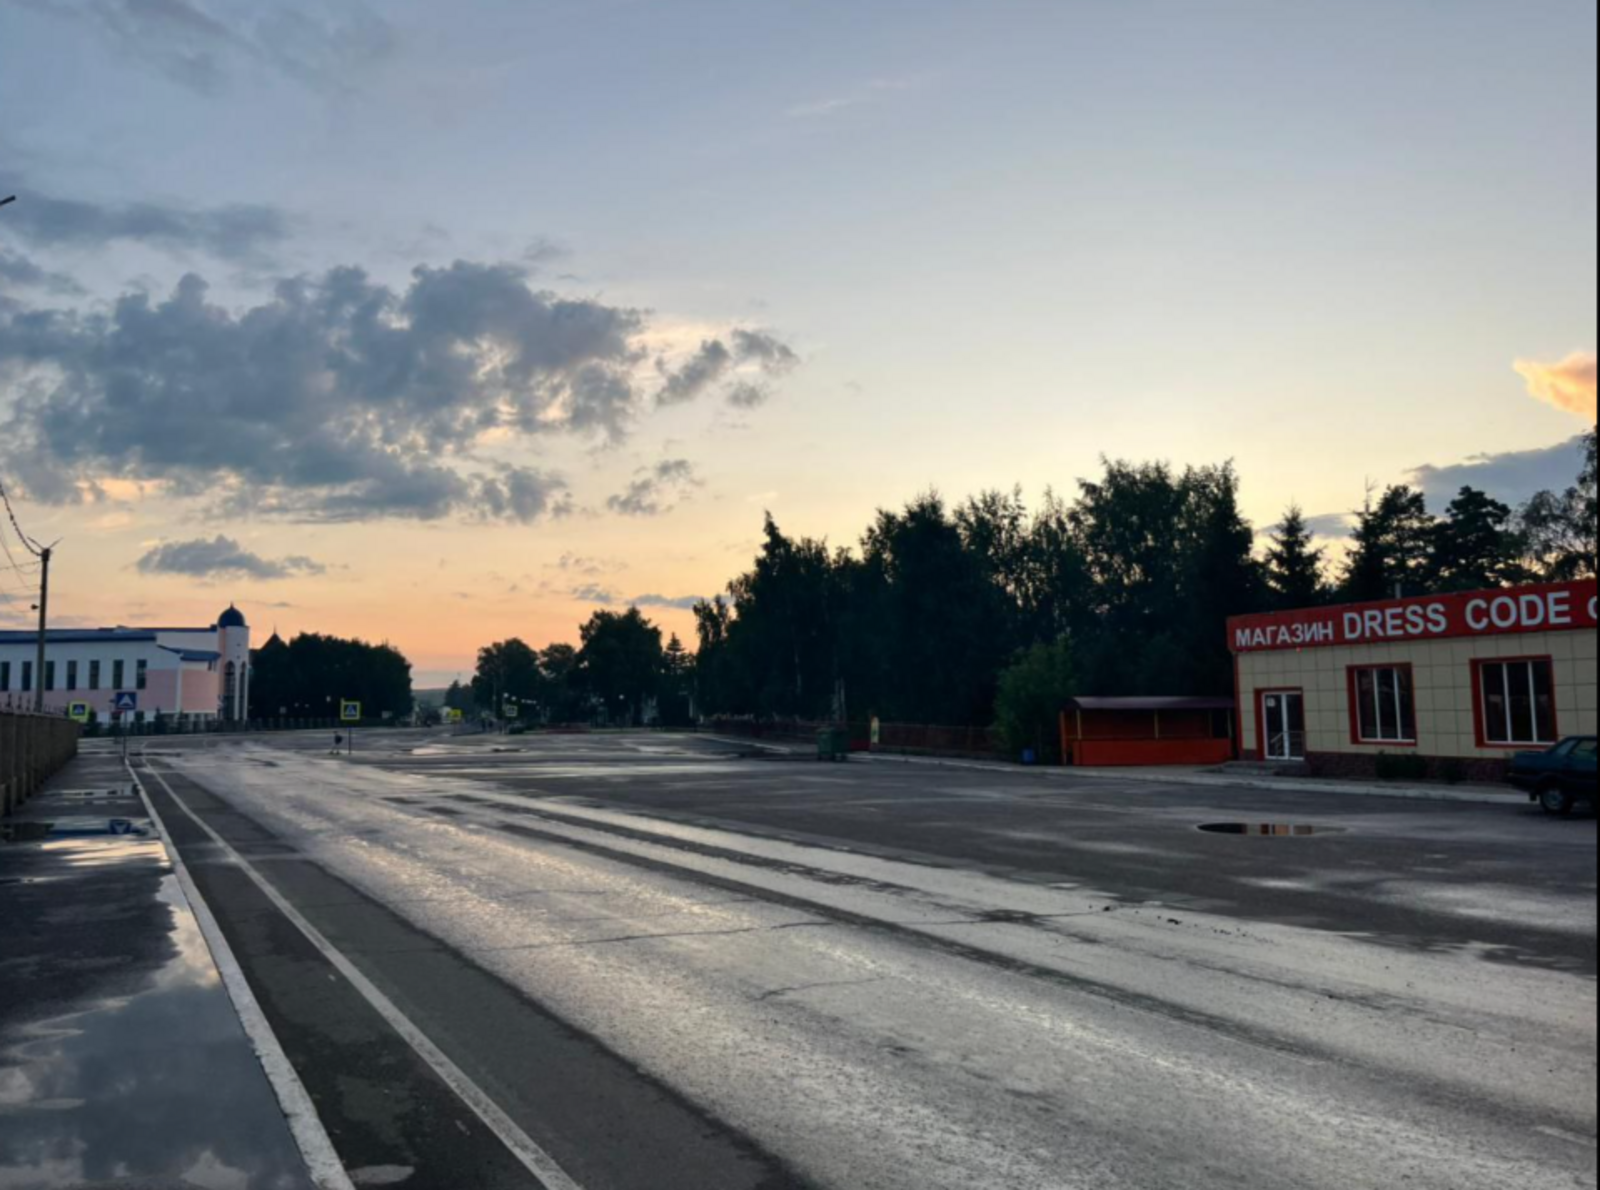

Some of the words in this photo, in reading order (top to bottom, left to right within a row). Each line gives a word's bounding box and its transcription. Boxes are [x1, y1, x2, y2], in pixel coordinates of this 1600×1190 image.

[1235, 621, 1334, 647] МАГАЗИН
[1343, 603, 1447, 639] DRESS
[1465, 591, 1571, 630] CODE
